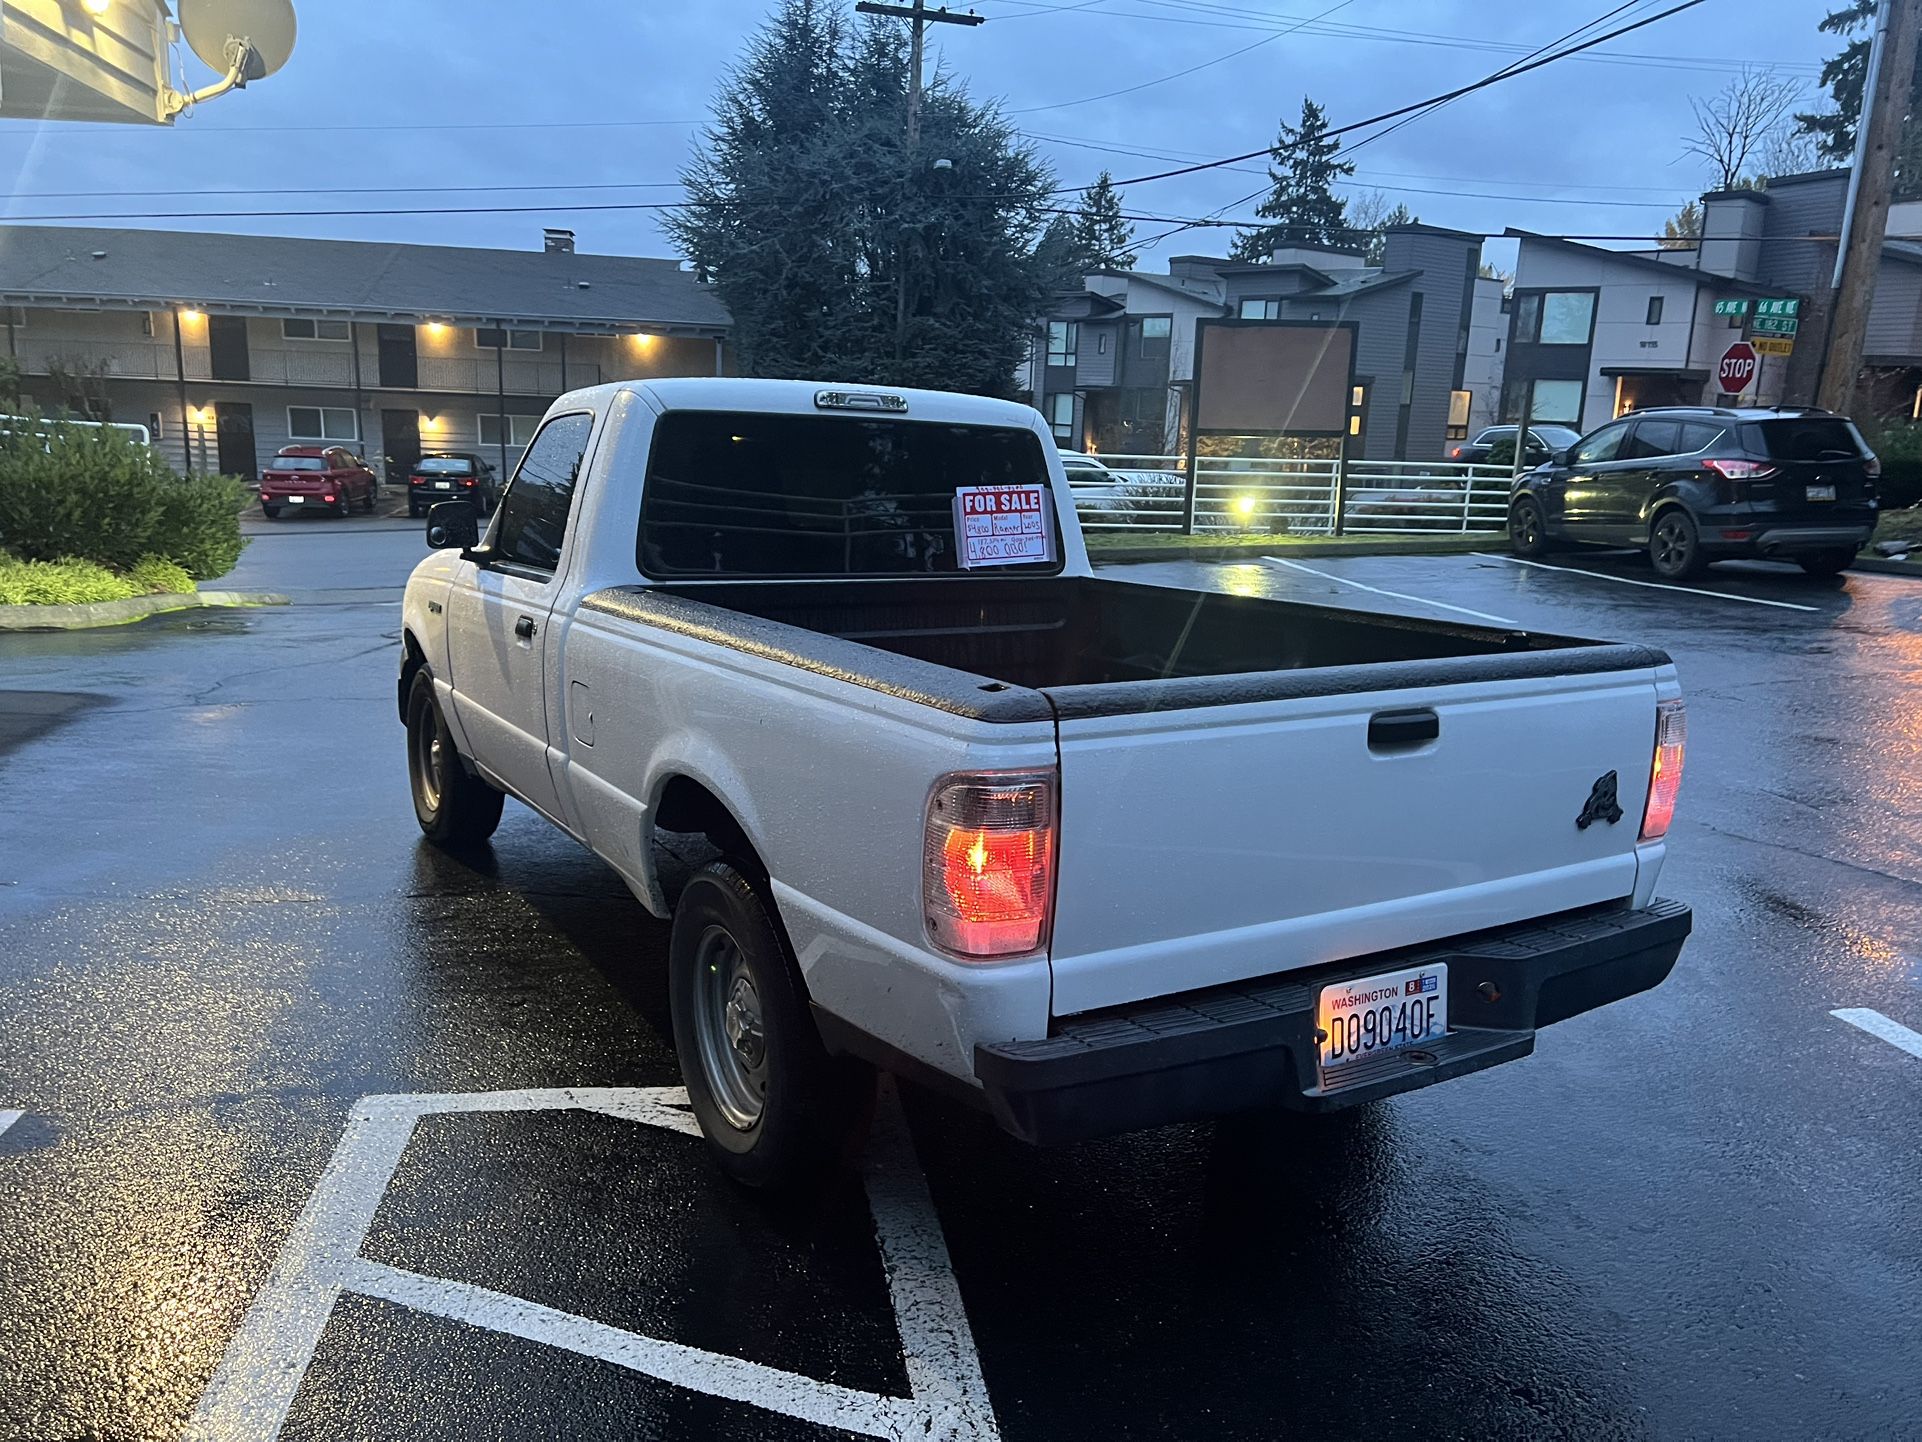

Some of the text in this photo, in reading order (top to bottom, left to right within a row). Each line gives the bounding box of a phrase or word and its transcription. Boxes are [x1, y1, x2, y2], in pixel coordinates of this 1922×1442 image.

[1715, 301, 1725, 314] 65
[1757, 300, 1797, 314] 66 AVE NE
[1781, 320, 1794, 331] ST
[1720, 358, 1754, 378] STOP
[965, 492, 1040, 513] FOR SALE
[994, 522, 1021, 534] Ranger
[1408, 981, 1415, 992] 8
[1332, 986, 1398, 1010] WASHINGTON
[1331, 995, 1440, 1060] D09040F
